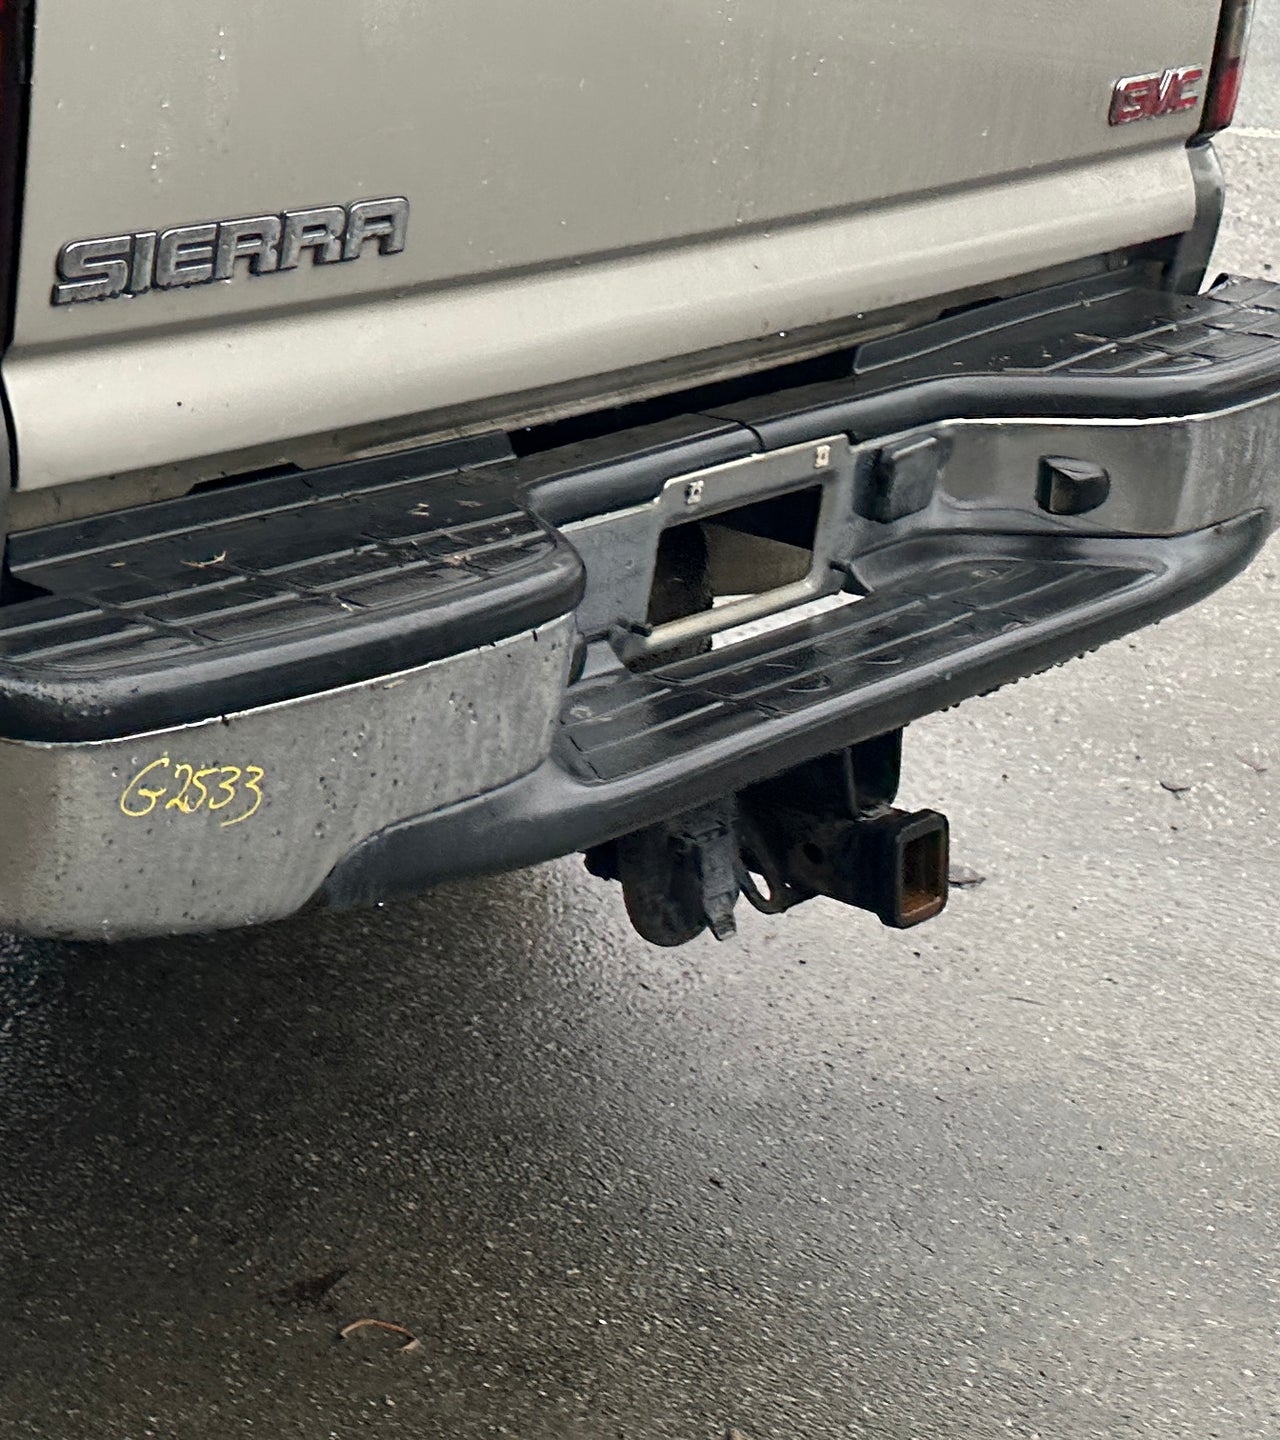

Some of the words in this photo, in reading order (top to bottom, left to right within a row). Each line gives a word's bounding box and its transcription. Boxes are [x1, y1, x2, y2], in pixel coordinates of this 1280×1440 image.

[1107, 64, 1203, 127] GMC
[50, 195, 410, 307] SIERRA
[120, 757, 265, 827] G2533
